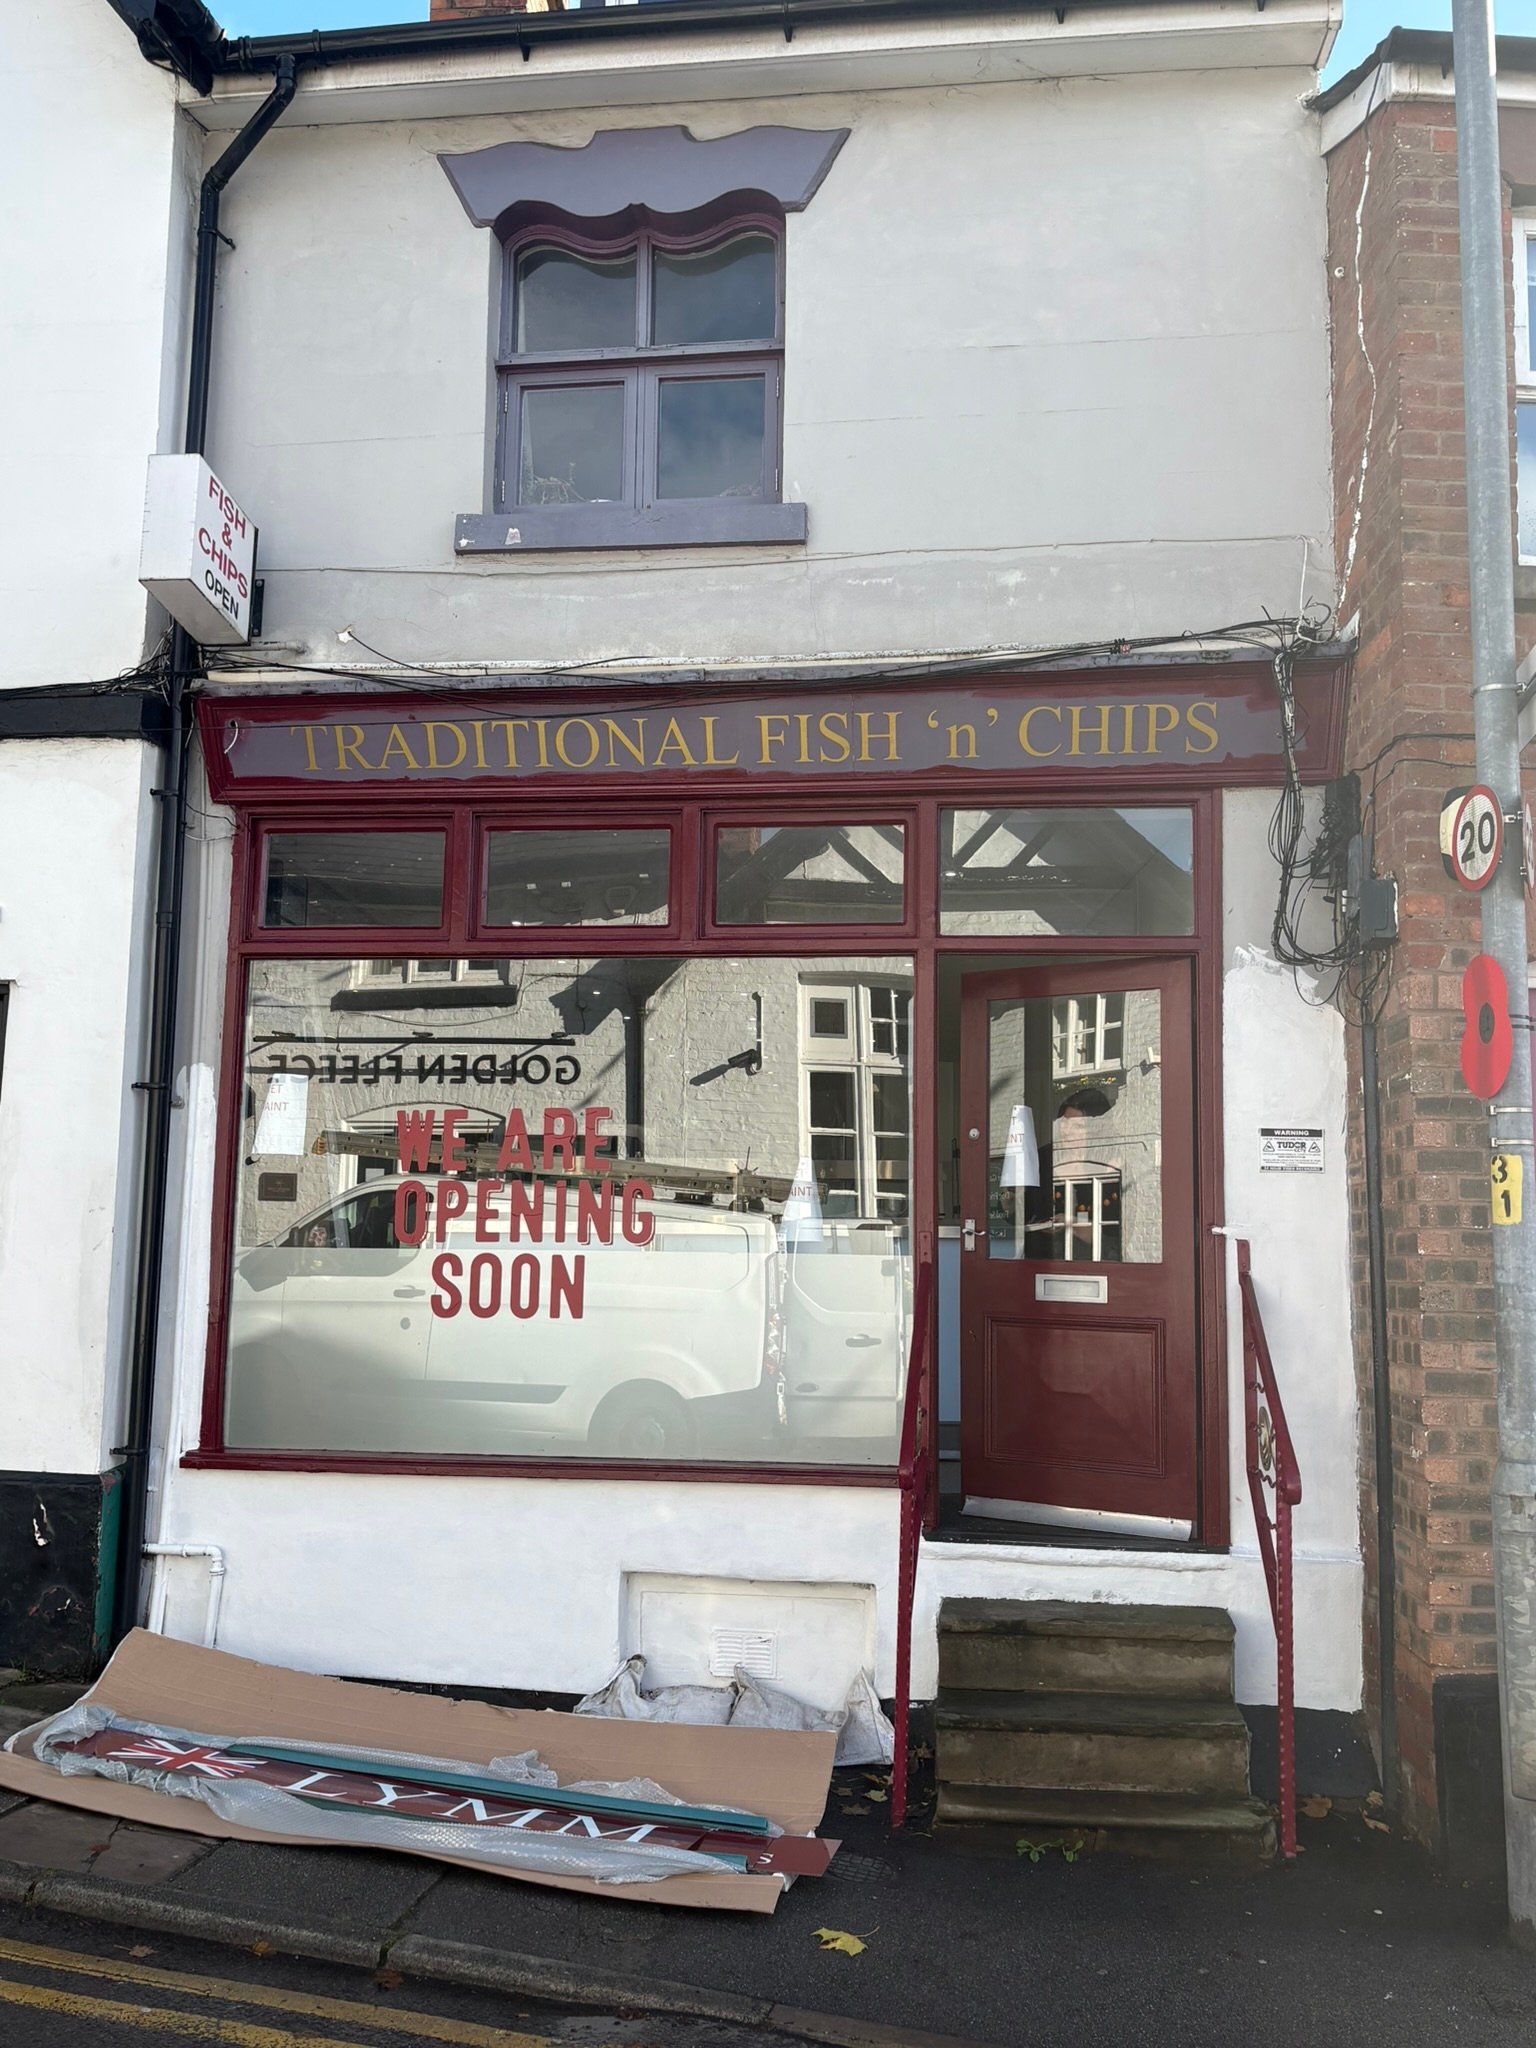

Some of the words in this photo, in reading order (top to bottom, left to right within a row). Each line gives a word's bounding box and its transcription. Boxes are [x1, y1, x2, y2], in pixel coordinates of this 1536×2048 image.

[208, 475, 247, 540] FISH
[221, 522, 232, 551] &
[198, 527, 249, 599] CHIPS
[204, 569, 239, 621] OPEN
[290, 715, 740, 772] TRADITIONAL
[754, 711, 903, 765] FISH
[1017, 701, 1220, 758] CHIPS
[1460, 811, 1496, 864] 20
[264, 1101, 289, 1112] AINT
[270, 1083, 285, 1095] ET
[397, 1108, 469, 1173] WE
[496, 1106, 614, 1173] ARE
[1273, 1129, 1310, 1137] WARNING
[1277, 1141, 1307, 1149] TUDOR
[1491, 1155, 1508, 1184] 3
[394, 1179, 656, 1246] OPENING
[1500, 1189, 1512, 1218] 1
[430, 1252, 586, 1320] SOON
[274, 1769, 669, 1843] LYMM
